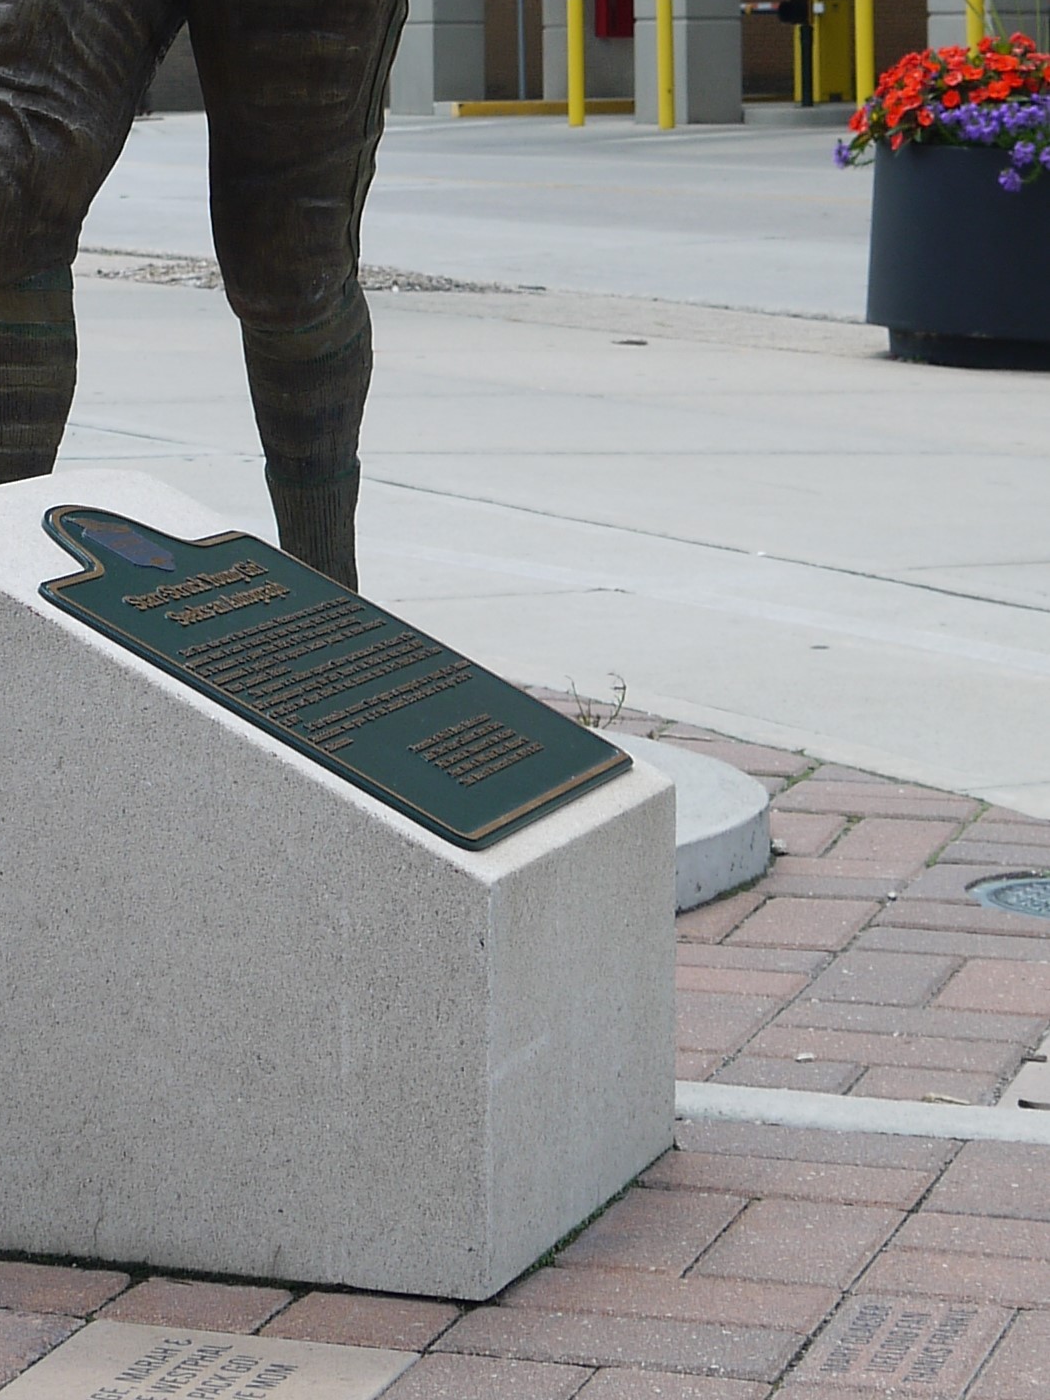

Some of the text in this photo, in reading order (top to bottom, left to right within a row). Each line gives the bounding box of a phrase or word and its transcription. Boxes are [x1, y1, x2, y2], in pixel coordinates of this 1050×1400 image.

[114, 1347, 183, 1383] MARAH
[146, 1344, 233, 1393] WESTPHAL
[186, 1373, 241, 1400] PACK
[221, 1354, 264, 1374] GO!
[244, 1363, 300, 1391] MOM
